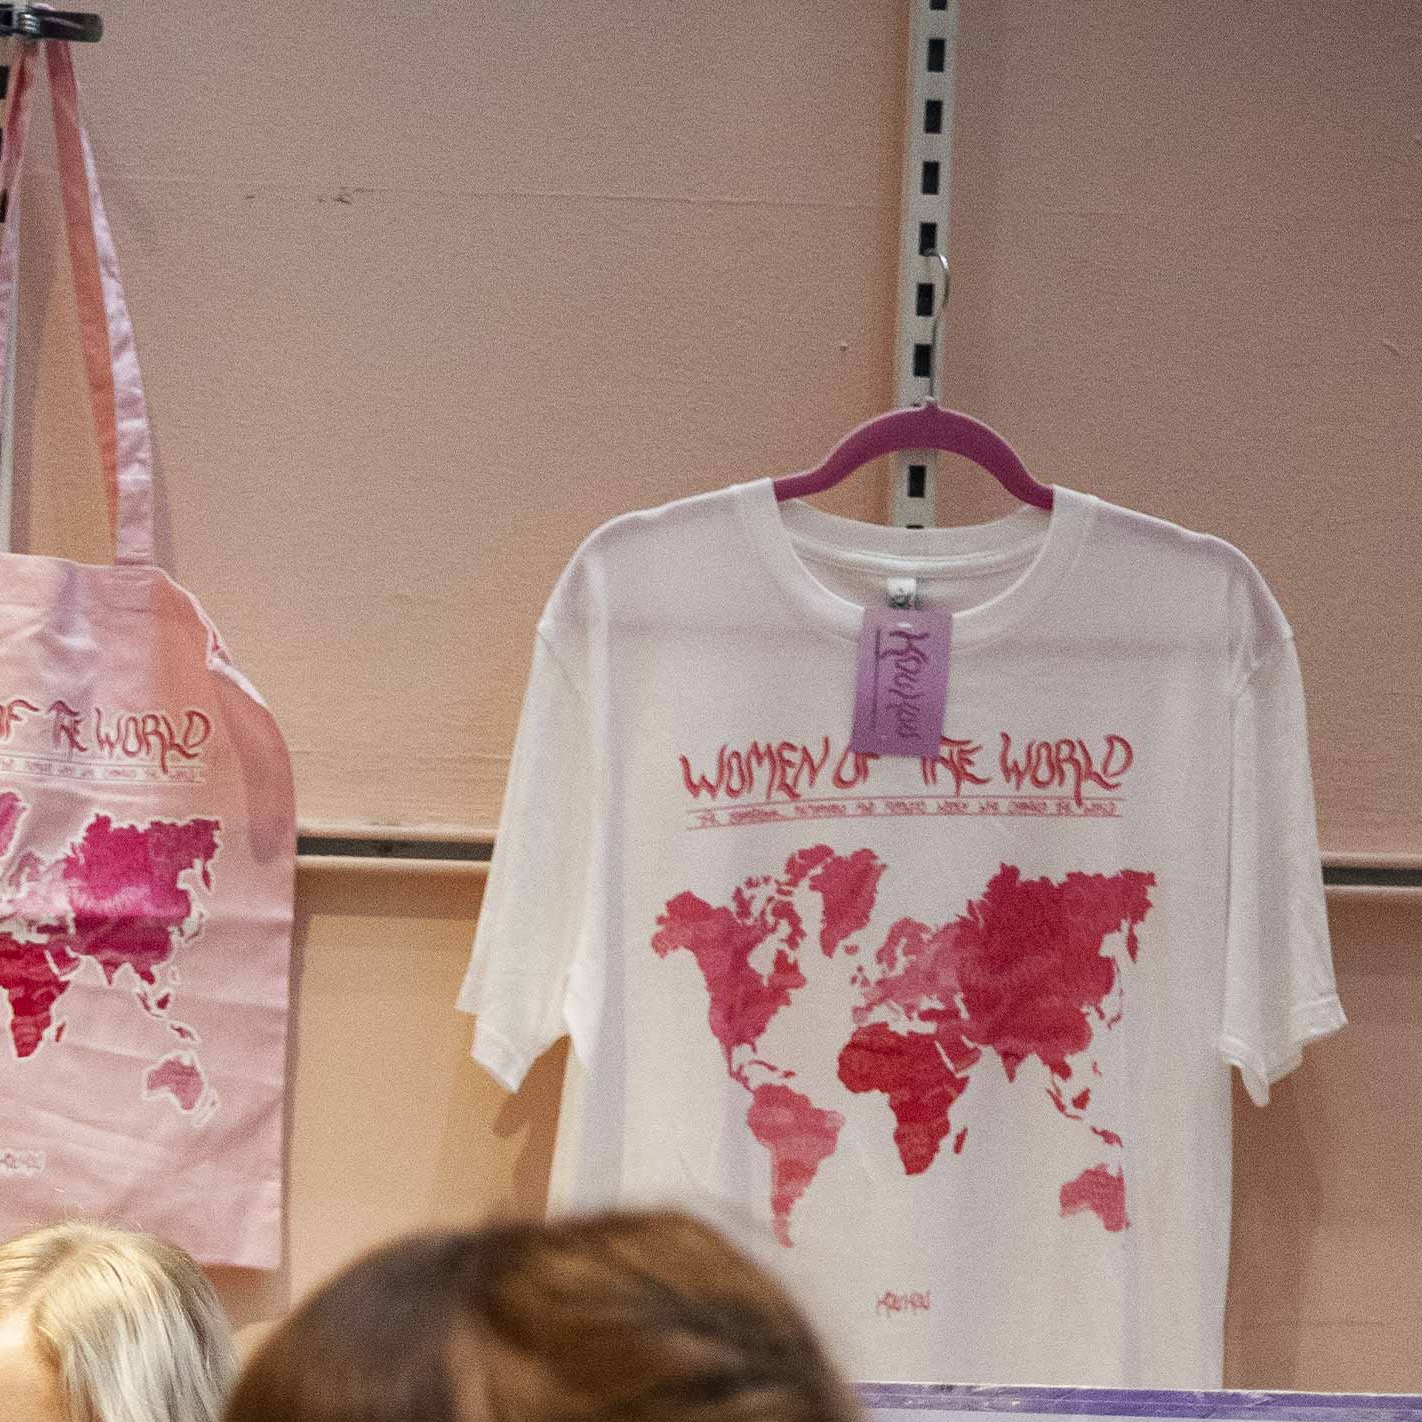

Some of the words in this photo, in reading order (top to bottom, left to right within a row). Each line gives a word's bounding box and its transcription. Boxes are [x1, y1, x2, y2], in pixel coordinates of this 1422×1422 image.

[94, 707, 212, 773] WORLD
[679, 735, 830, 800] WOMEN
[1000, 732, 1134, 805] WORLD
